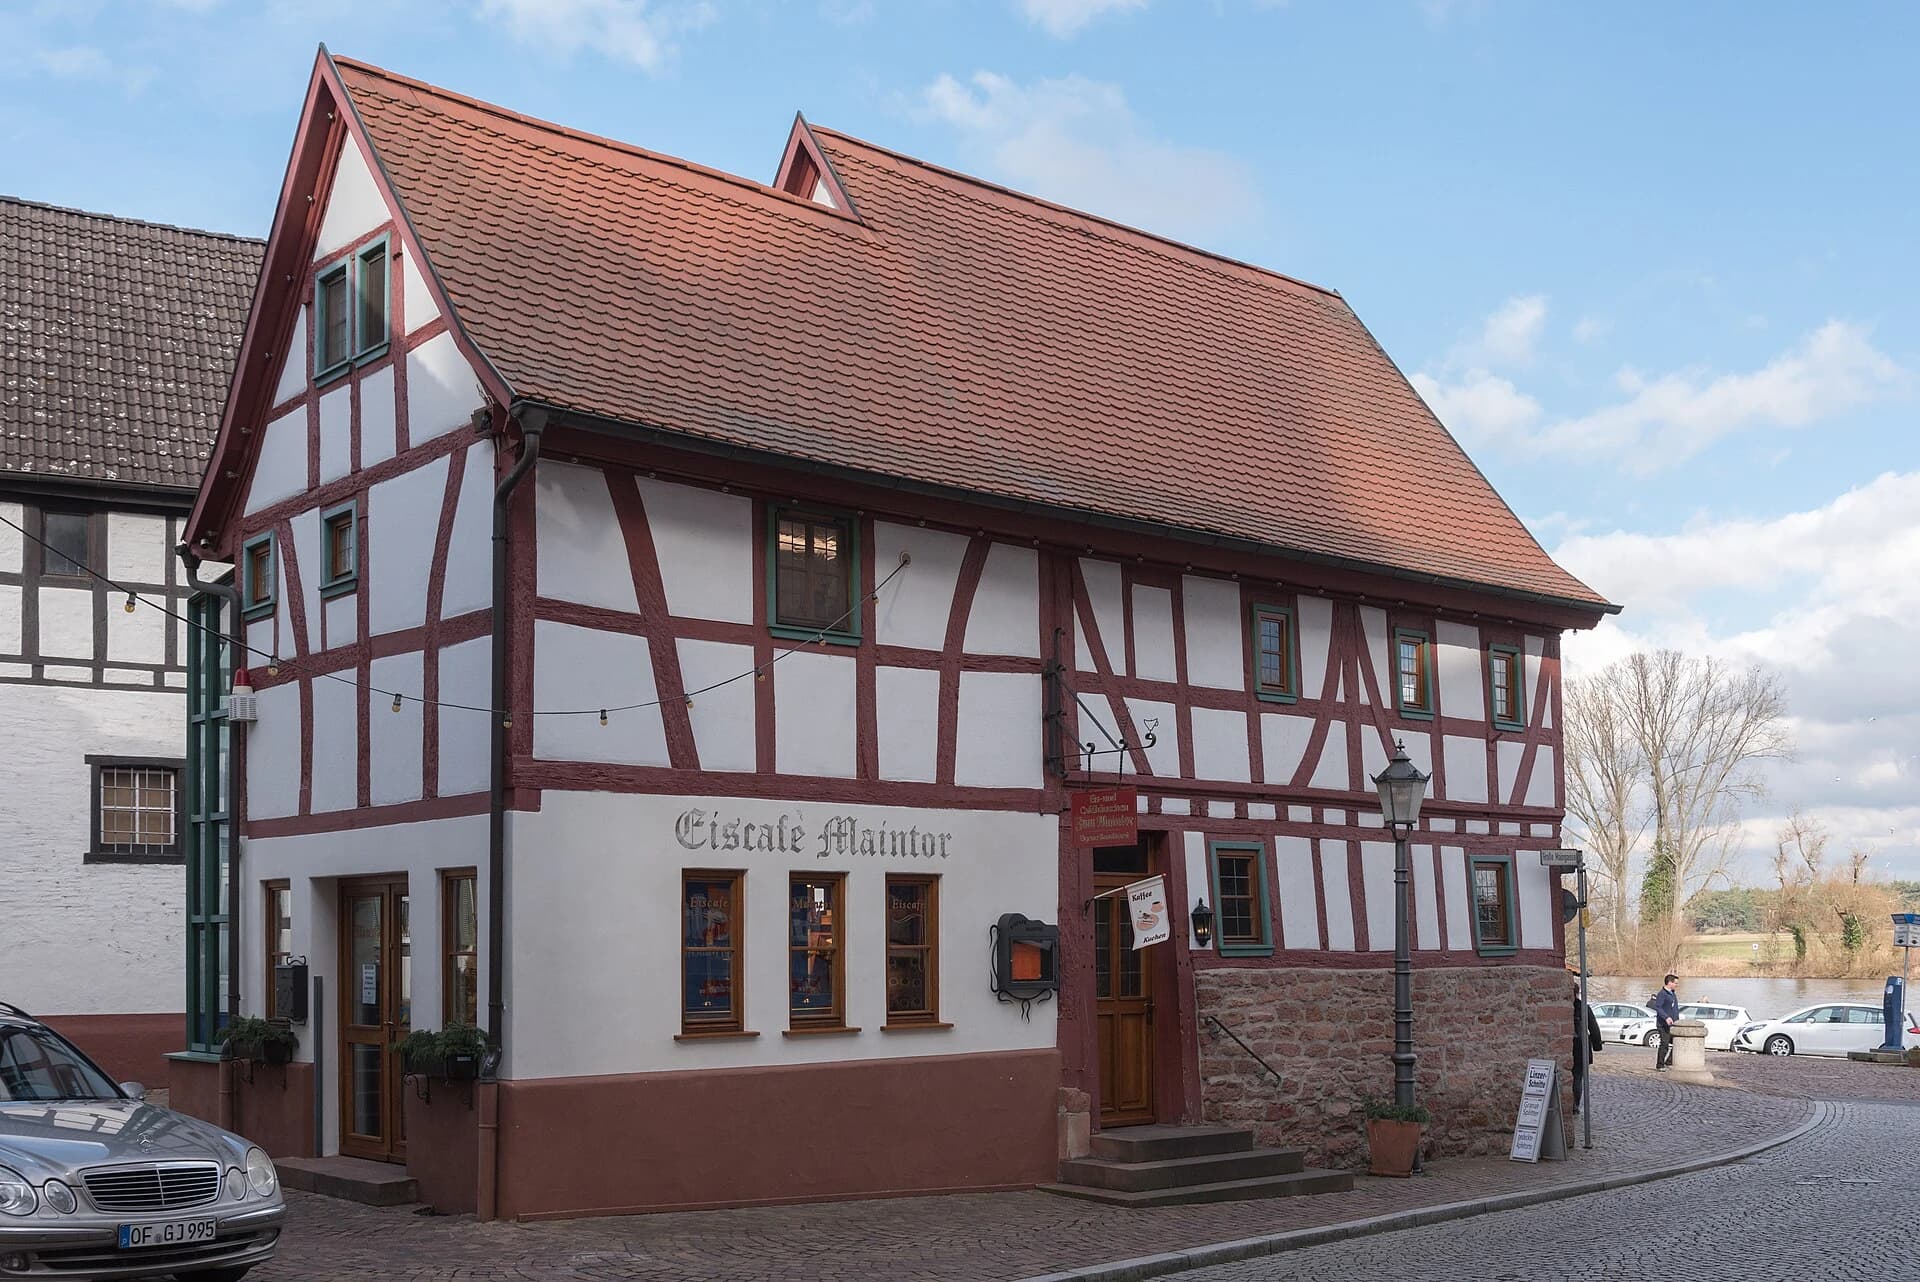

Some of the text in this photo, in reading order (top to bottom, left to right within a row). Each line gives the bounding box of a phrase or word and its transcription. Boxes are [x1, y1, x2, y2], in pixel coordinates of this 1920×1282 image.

[816, 815, 952, 859] Maintor
[1131, 891, 1153, 902] Kaffee
[1143, 932, 1167, 943] Kuchen
[131, 1227, 152, 1244] OF
